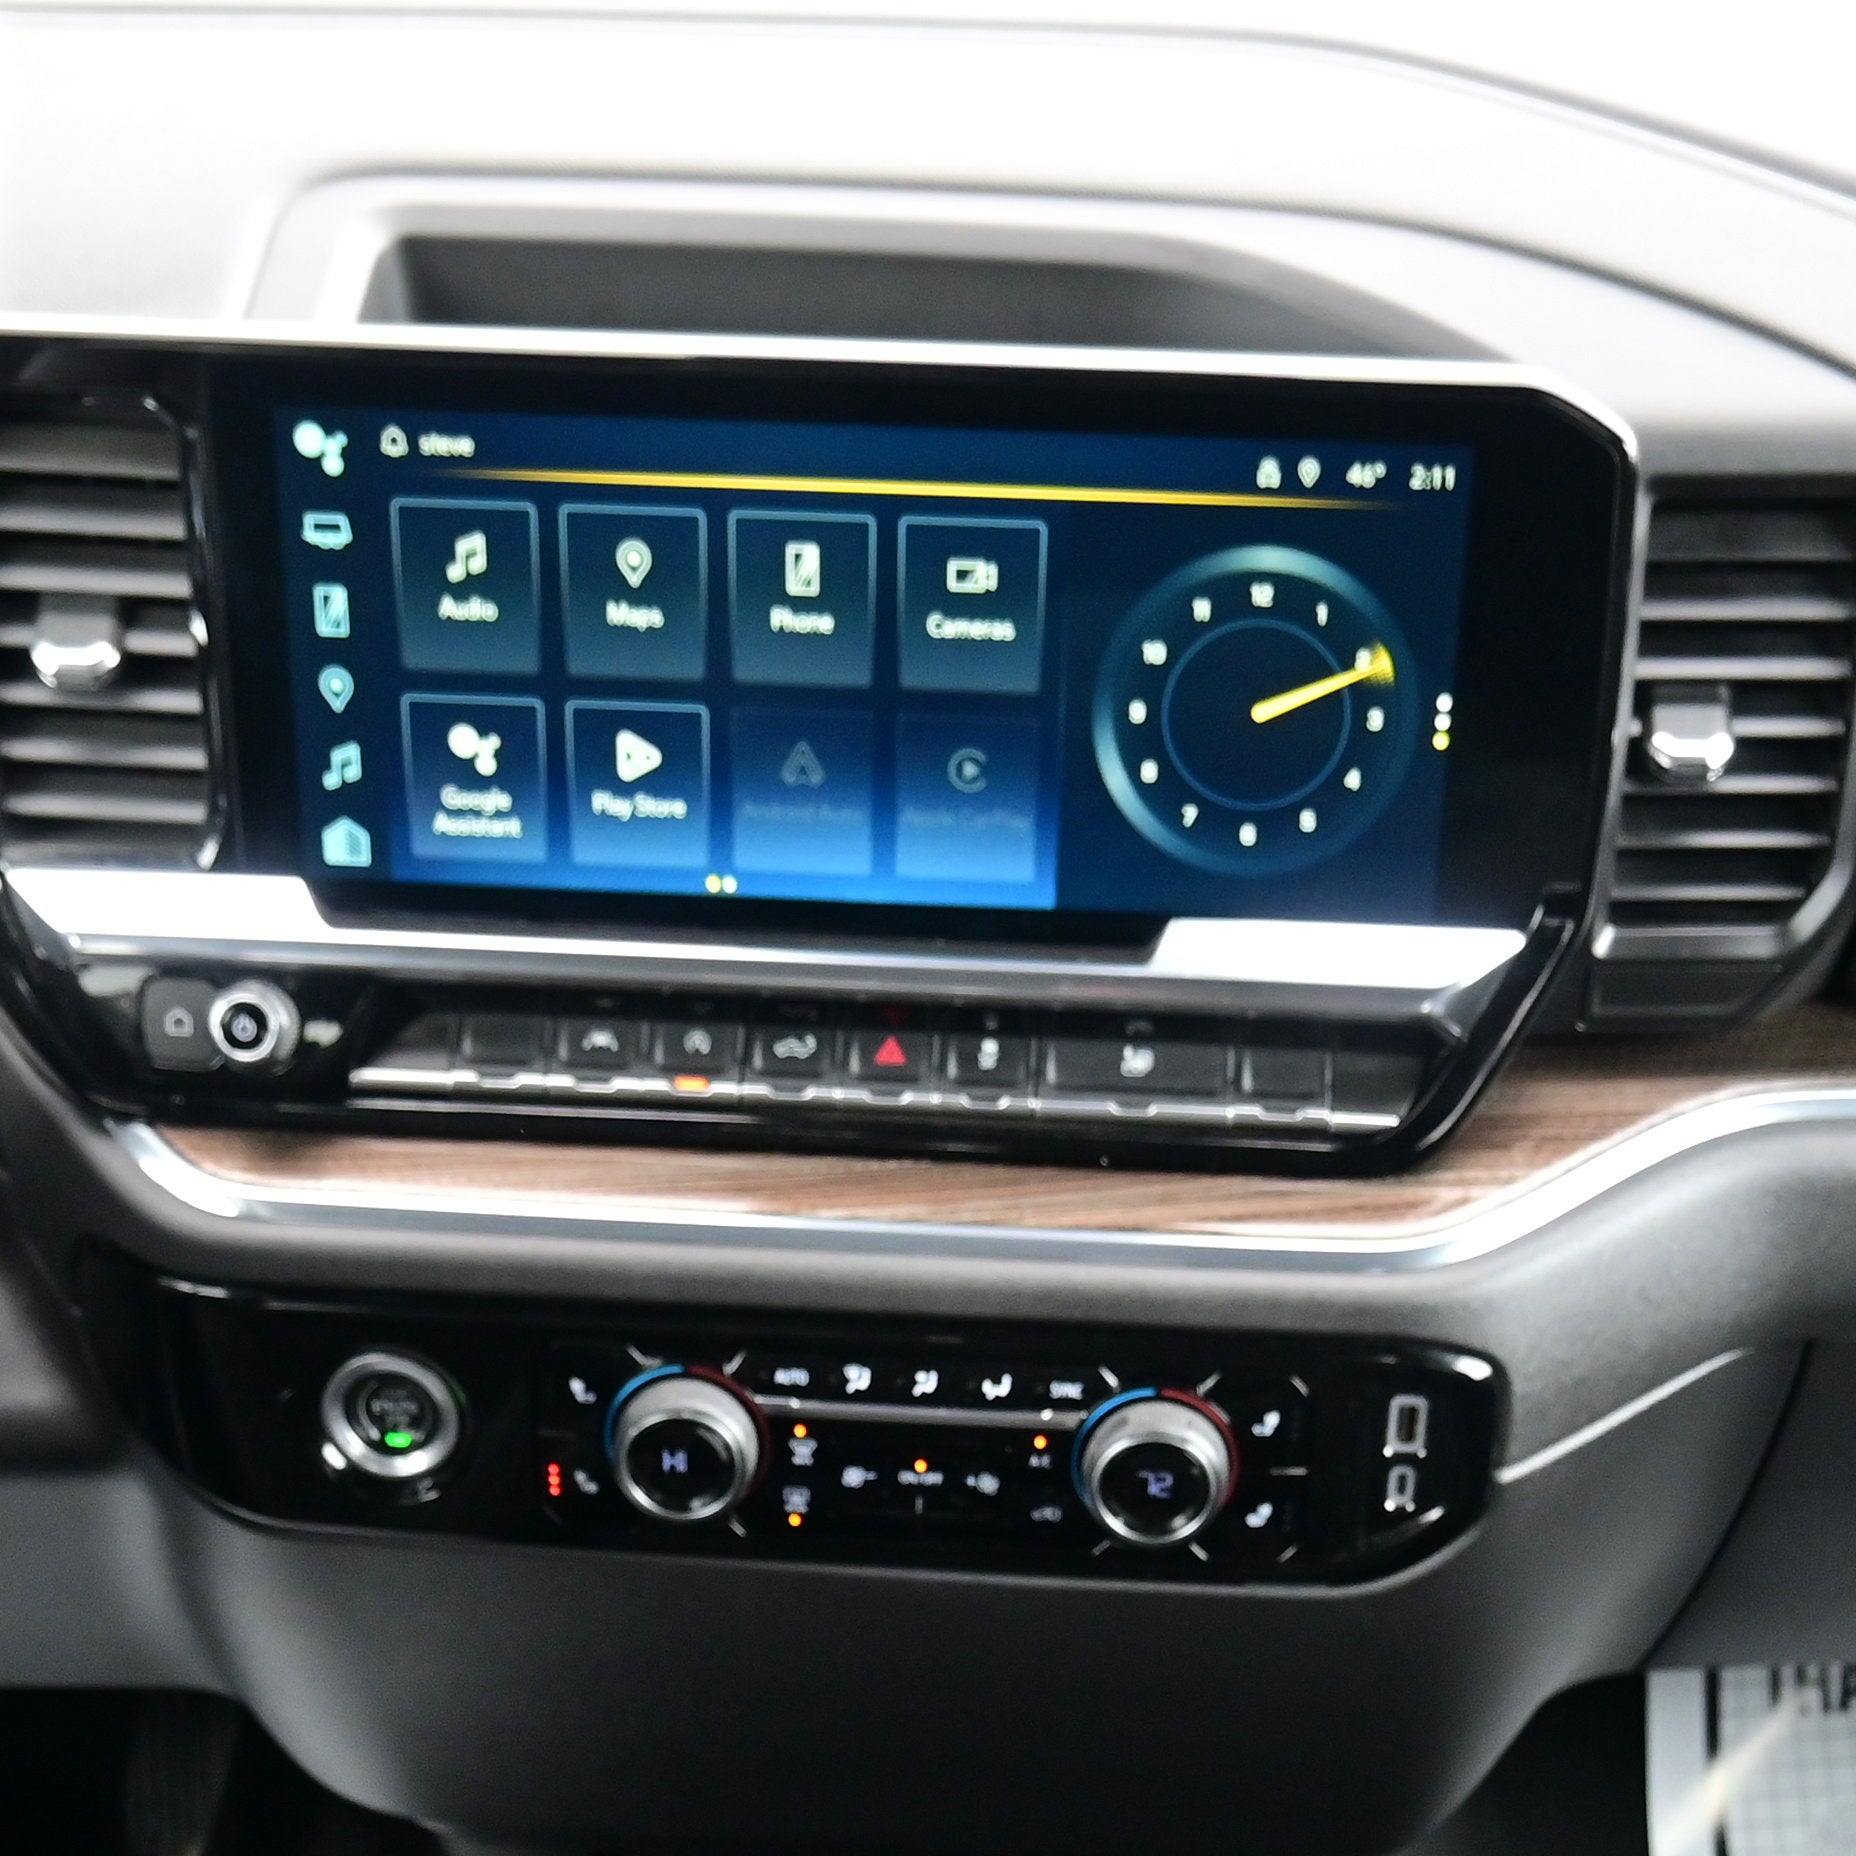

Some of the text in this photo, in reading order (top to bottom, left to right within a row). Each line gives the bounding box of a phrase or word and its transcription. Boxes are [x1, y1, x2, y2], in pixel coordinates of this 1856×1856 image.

[417, 431, 475, 458] steve
[1409, 463, 1456, 491] 2:11
[438, 593, 499, 622] Audio
[1249, 581, 1275, 608] 12
[606, 599, 665, 632] Maps
[769, 604, 836, 635] Phone
[1191, 596, 1212, 623] 11
[1316, 600, 1328, 627] 1
[925, 611, 1017, 642] Cameras
[1141, 638, 1168, 666] 10
[1343, 766, 1362, 792] 4
[440, 784, 512, 816] Google
[591, 788, 688, 822] Play Store
[432, 811, 523, 839] Assistant
[1181, 803, 1200, 828] 7
